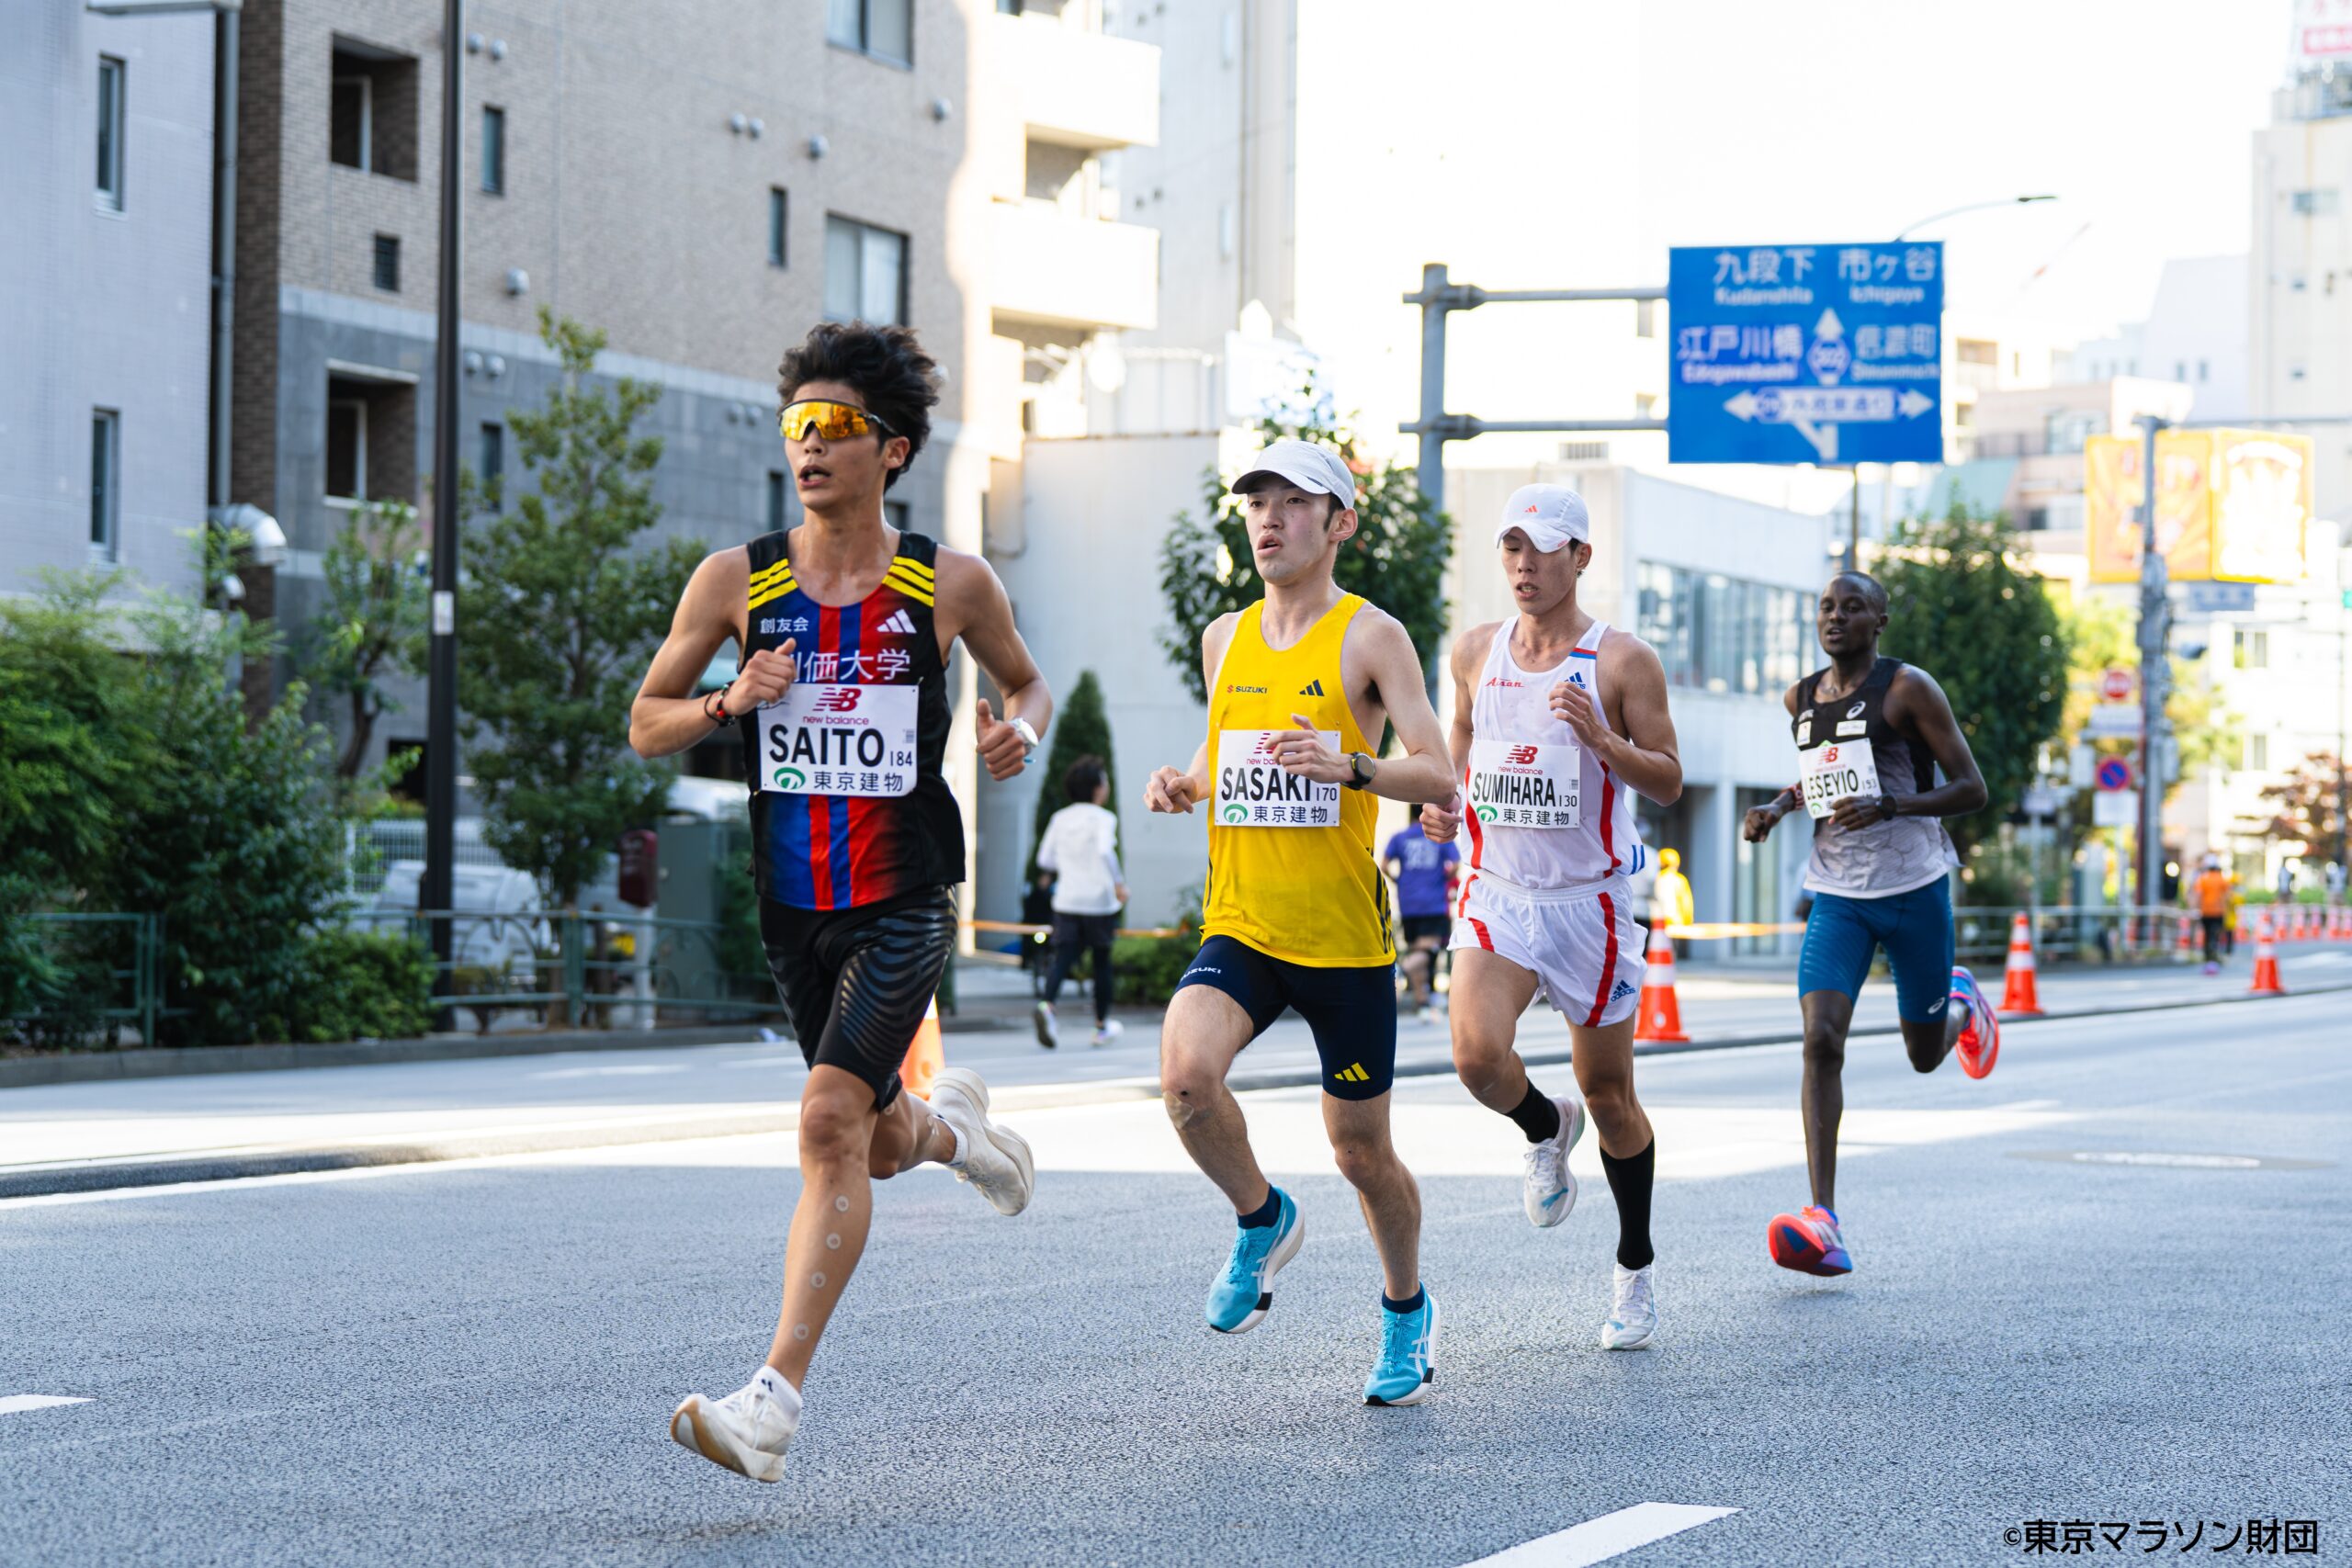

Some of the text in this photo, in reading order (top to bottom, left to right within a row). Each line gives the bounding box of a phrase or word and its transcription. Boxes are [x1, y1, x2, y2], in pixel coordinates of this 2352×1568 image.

[1713, 249, 1815, 284] 九段下
[760, 616, 809, 634] 創友会
[1236, 685, 1268, 694] SUZUKI
[803, 716, 869, 725] new balance
[769, 724, 885, 767] SAITO
[890, 750, 912, 767] 184
[1513, 766, 1543, 774] balance
[814, 772, 903, 792] 東京建物
[1221, 767, 1311, 801] SASAKI
[1473, 773, 1555, 807] SUMIHARA
[1317, 787, 1337, 801] 170
[1559, 795, 1577, 807] 130
[1254, 807, 1328, 823] 東京建物
[1503, 808, 1569, 825] 東京建物
[1611, 987, 1635, 1001] adidas
